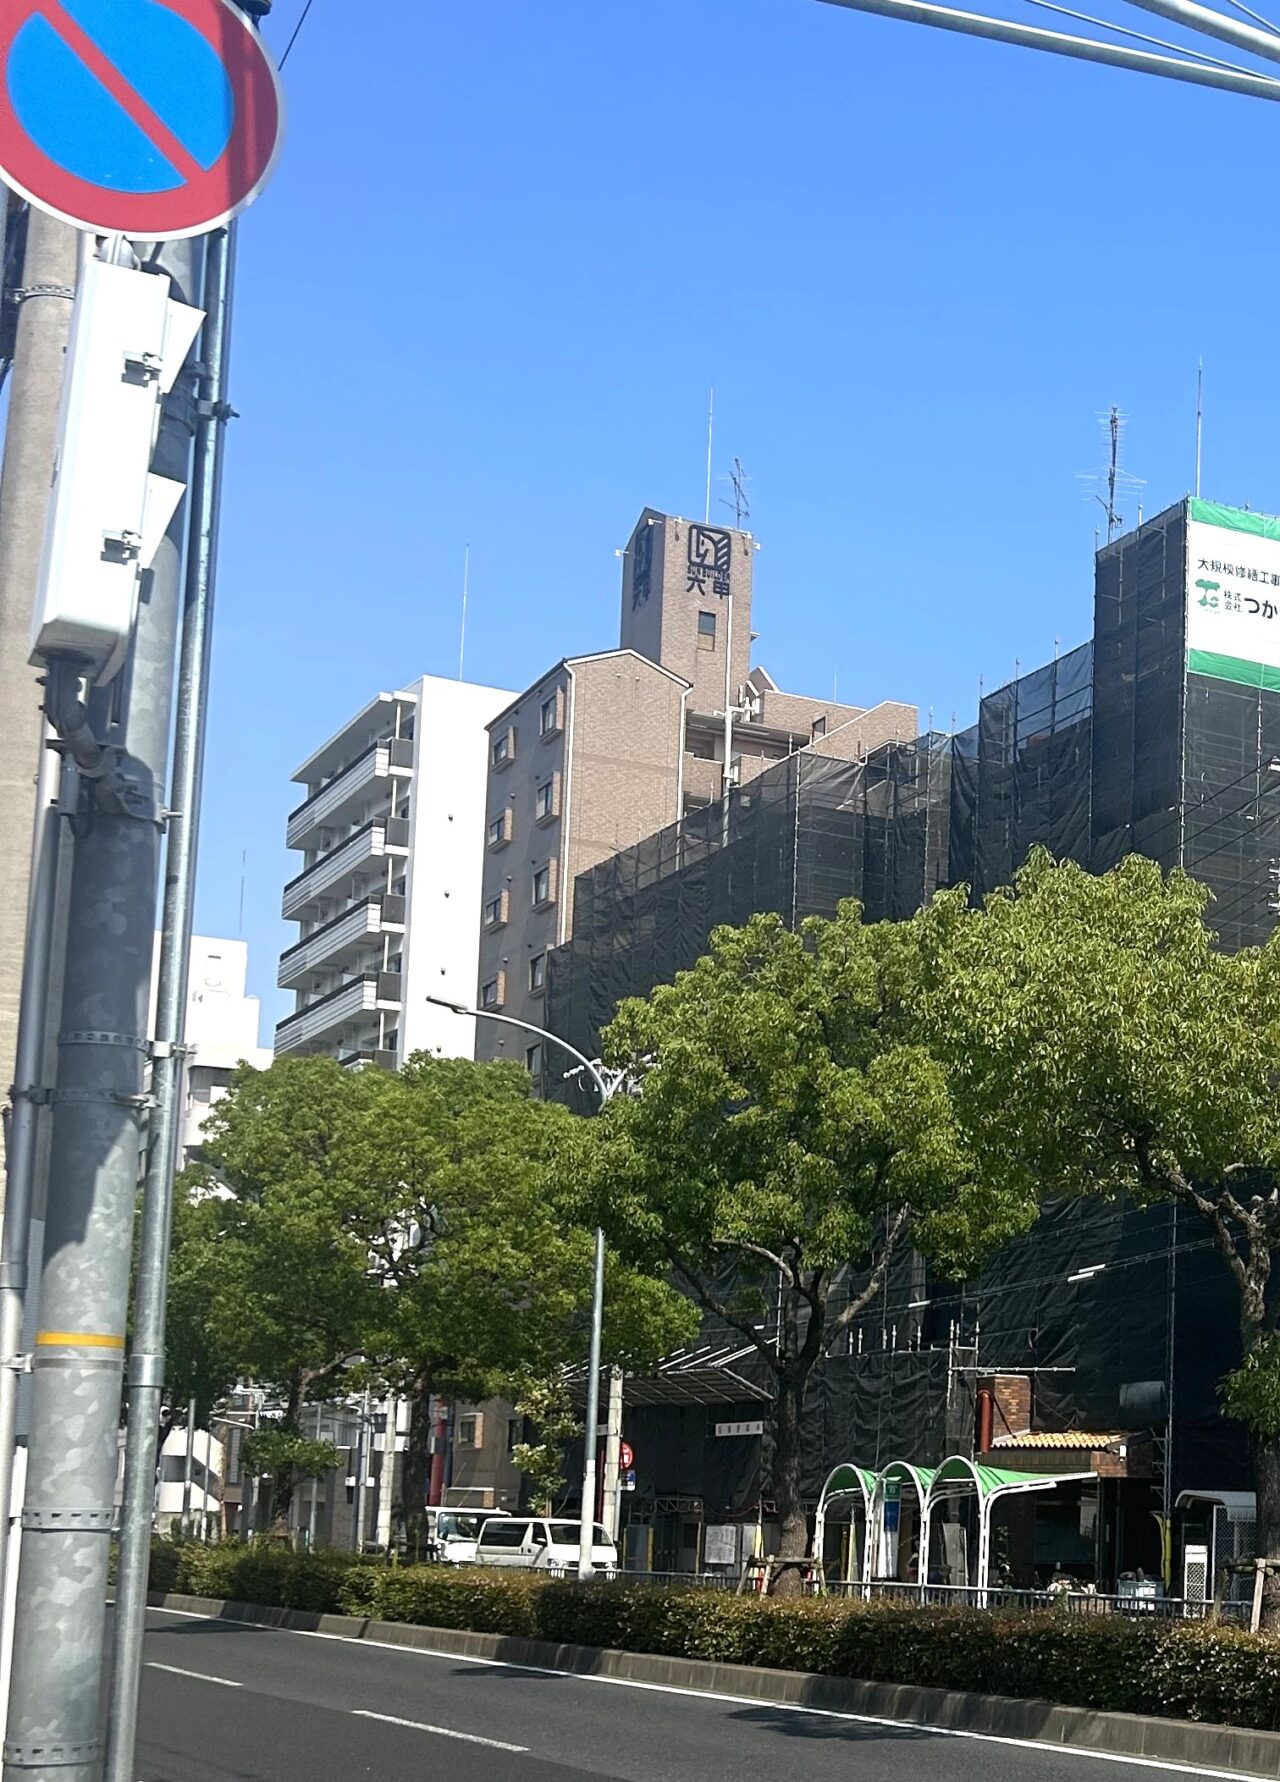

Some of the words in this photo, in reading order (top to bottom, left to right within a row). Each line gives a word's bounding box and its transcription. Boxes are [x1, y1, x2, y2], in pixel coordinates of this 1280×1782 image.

[1197, 558, 1280, 587] 大規模修繕工事
[686, 576, 730, 600] 六甲
